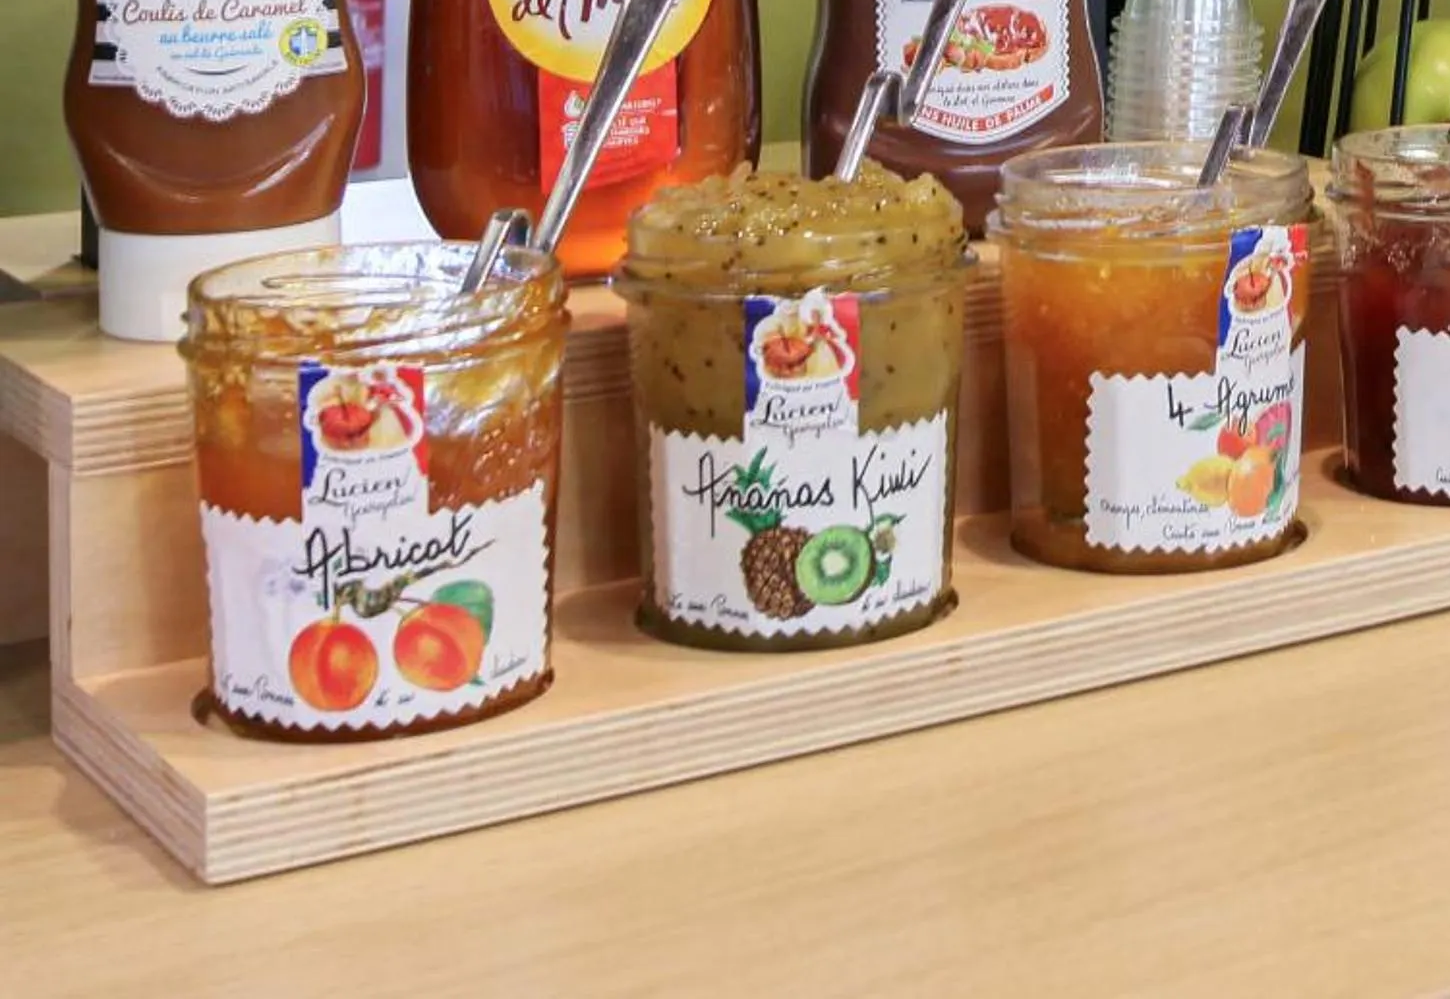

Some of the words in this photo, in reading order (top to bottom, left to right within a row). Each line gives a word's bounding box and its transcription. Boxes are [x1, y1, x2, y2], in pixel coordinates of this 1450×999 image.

[942, 114, 981, 131] HUILE
[985, 112, 1004, 129] DE
[1006, 94, 1042, 124] PALME
[1221, 327, 1284, 360] Lucien
[749, 390, 844, 429] Lucien
[1167, 382, 1194, 428] 4
[308, 466, 412, 508] Lucien
[682, 450, 836, 538] Ananas
[852, 444, 933, 512] Kiwi
[292, 513, 474, 611] Abricot
